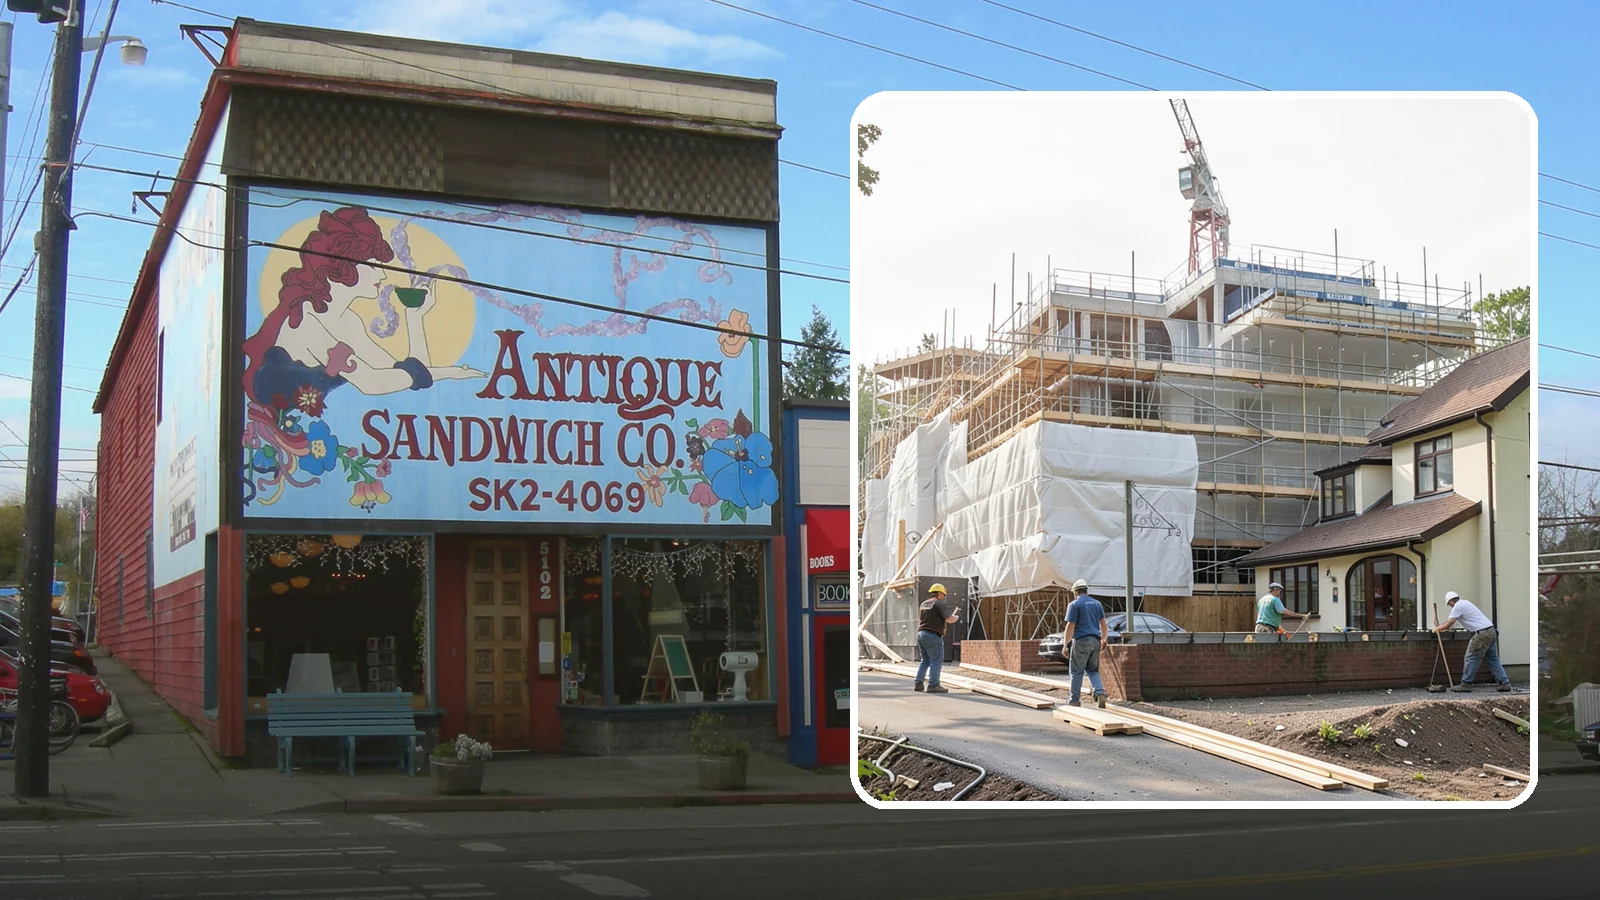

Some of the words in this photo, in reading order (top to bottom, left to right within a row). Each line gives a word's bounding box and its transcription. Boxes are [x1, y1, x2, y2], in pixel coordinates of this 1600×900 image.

[476, 329, 723, 421] ANTIQUE
[361, 409, 604, 467] SANDWICH
[618, 422, 685, 468] CO.
[468, 477, 645, 513] SK2-4069
[540, 542, 552, 599] 5102
[809, 555, 835, 569] BOOKS
